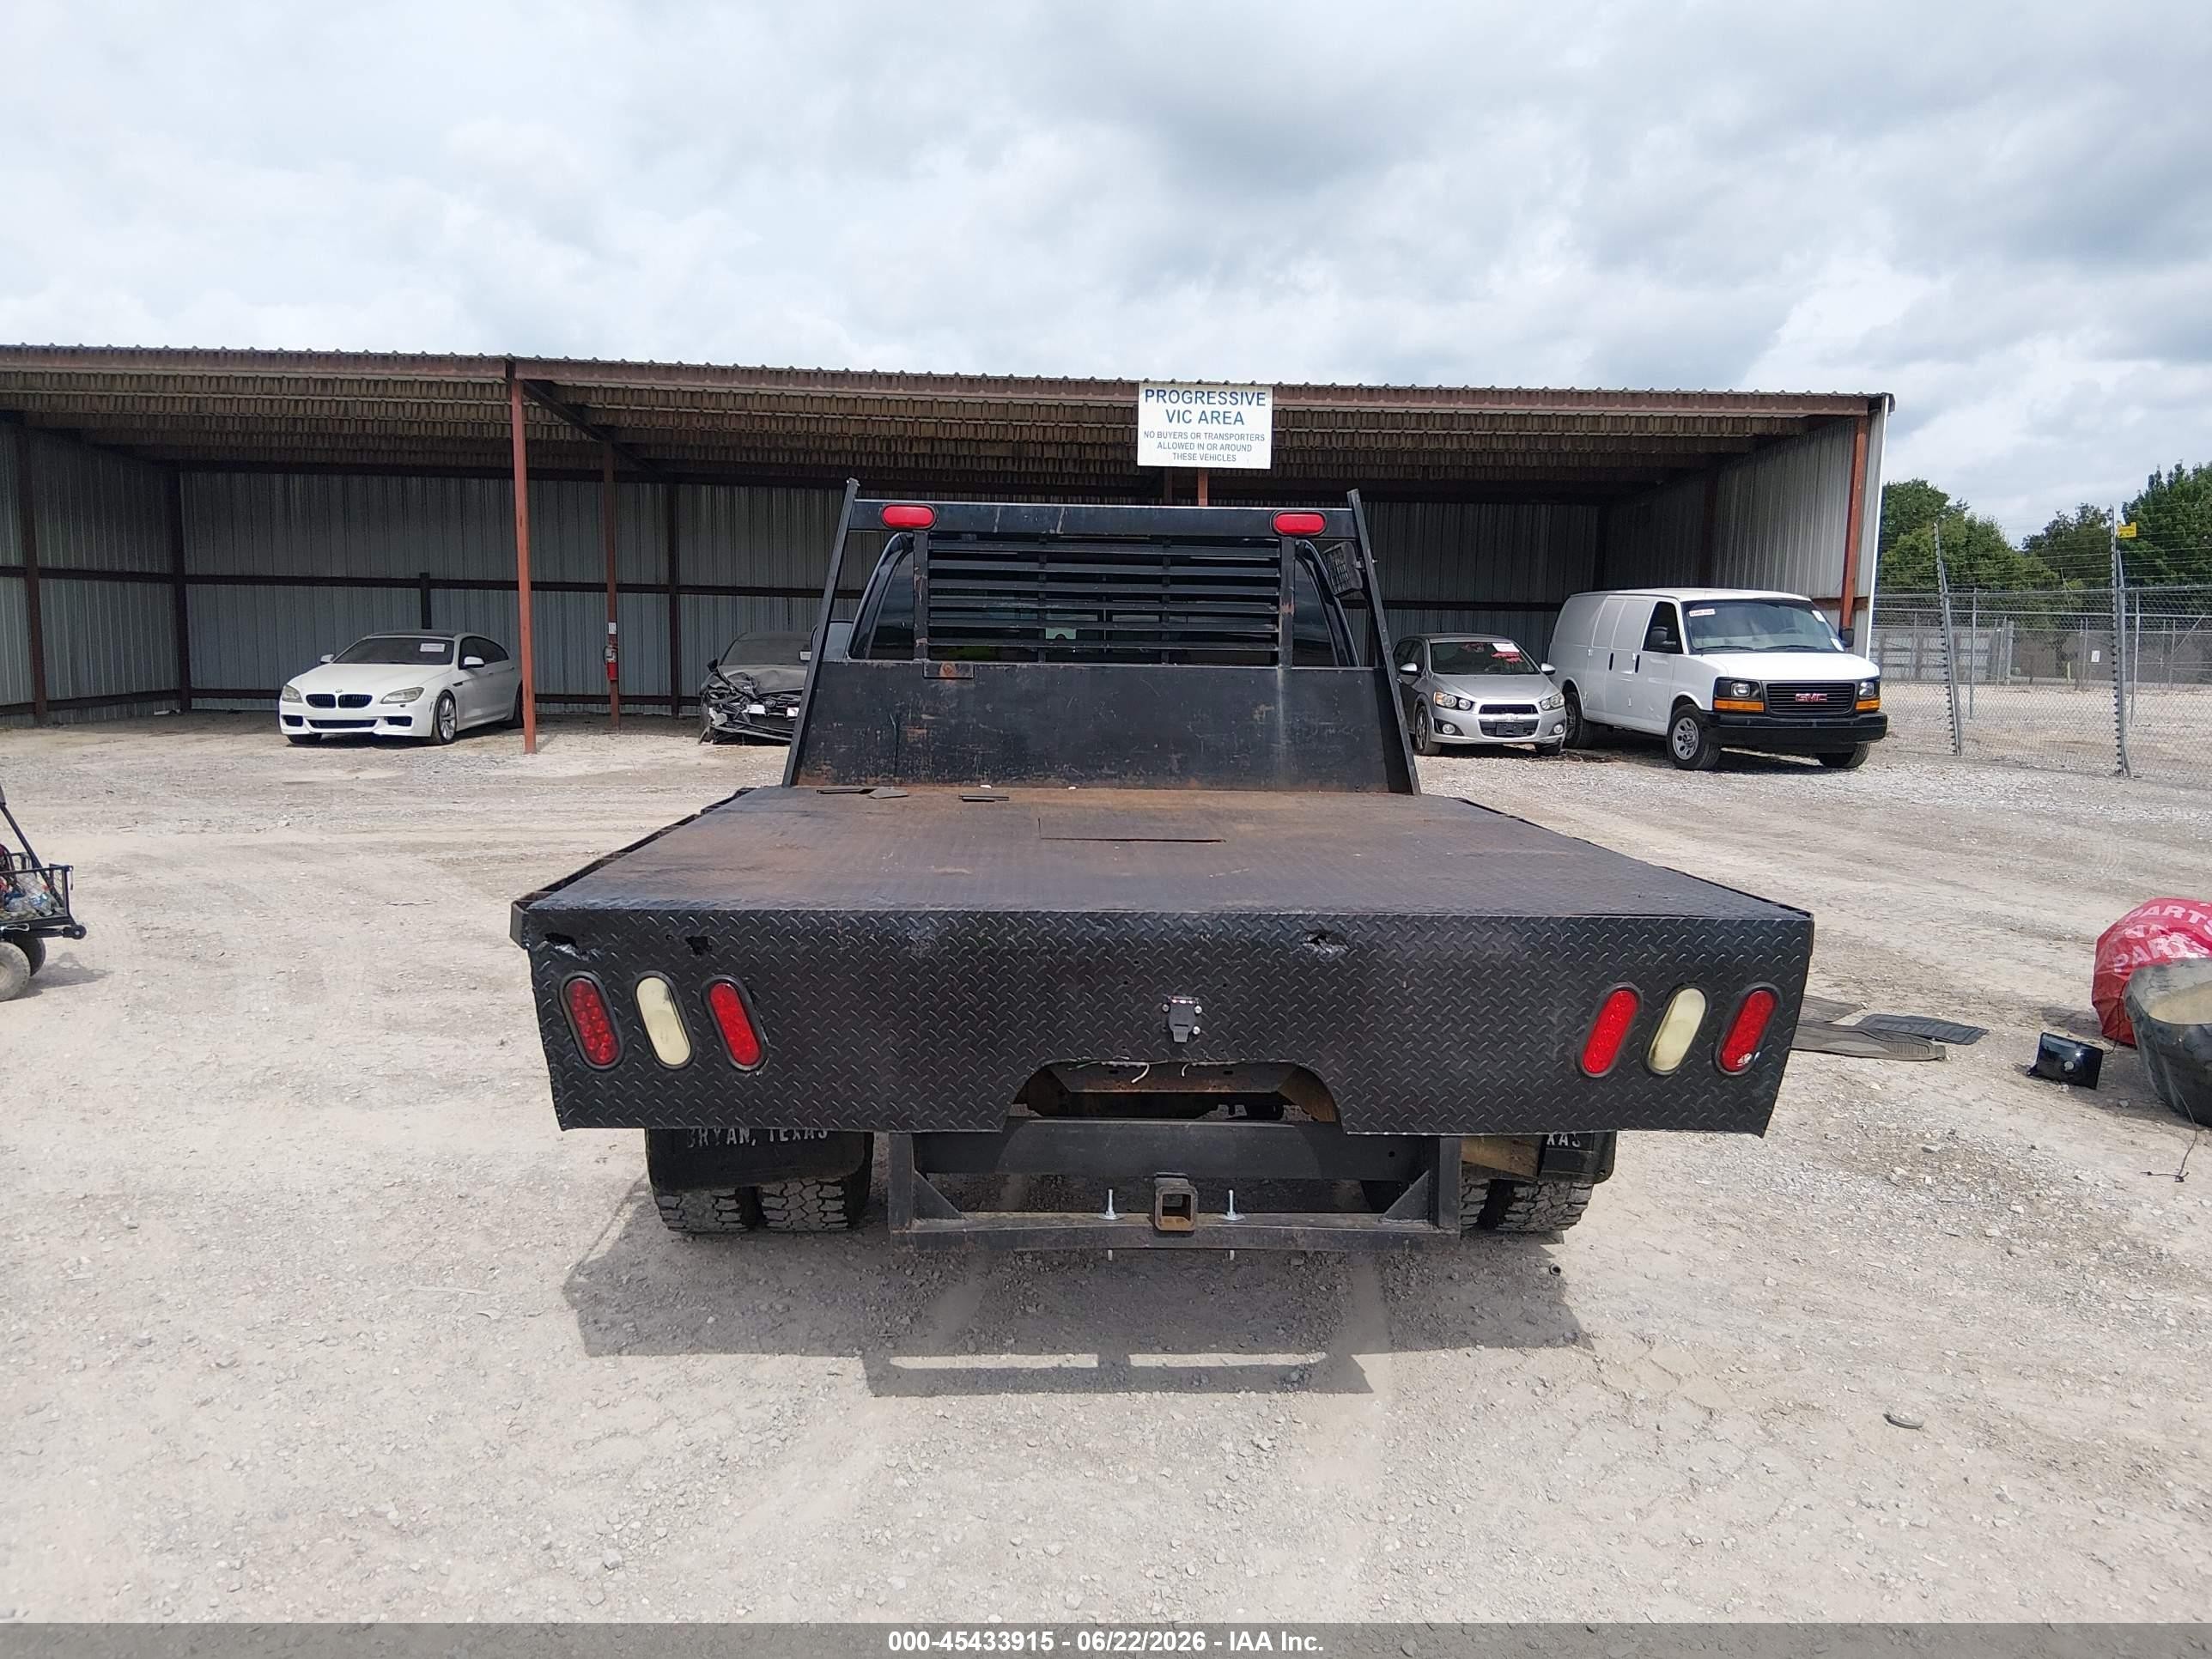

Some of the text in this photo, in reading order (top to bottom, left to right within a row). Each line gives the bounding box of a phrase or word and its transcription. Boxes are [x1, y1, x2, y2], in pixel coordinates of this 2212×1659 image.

[1145, 389, 1266, 406] PROGRESSIVE
[1165, 410, 1244, 425] VIC AREA
[1157, 431, 1188, 440] BUYERS
[1204, 432, 1265, 441] TRANSPORTERS
[1157, 441, 1195, 451] ALLOWED
[1197, 442, 1205, 451] IN
[1219, 443, 1253, 452] AROUND
[1172, 453, 1237, 462] THESE VEHICLES
[1795, 693, 1828, 702] GMC
